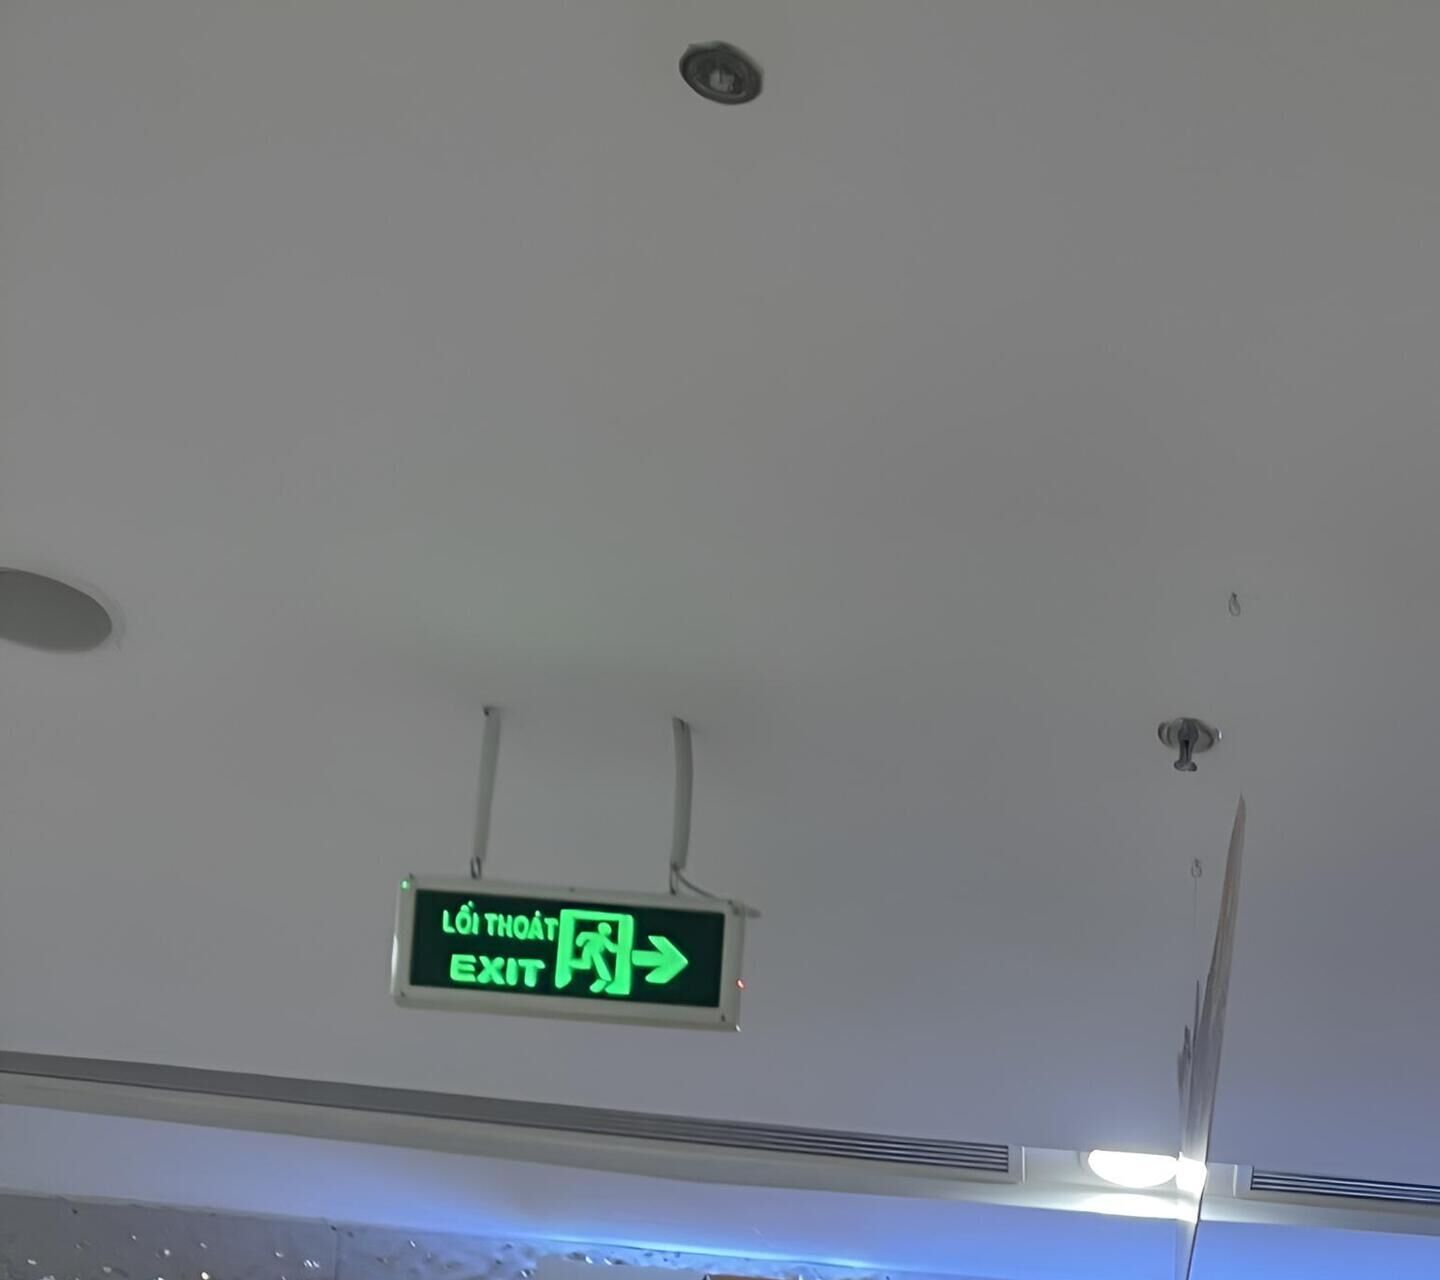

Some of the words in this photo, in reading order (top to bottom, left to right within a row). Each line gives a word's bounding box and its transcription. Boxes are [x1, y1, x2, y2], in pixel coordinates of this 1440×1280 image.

[442, 900, 480, 935] LỐI
[484, 910, 559, 941] THOÁT
[450, 953, 546, 988] EXIT
